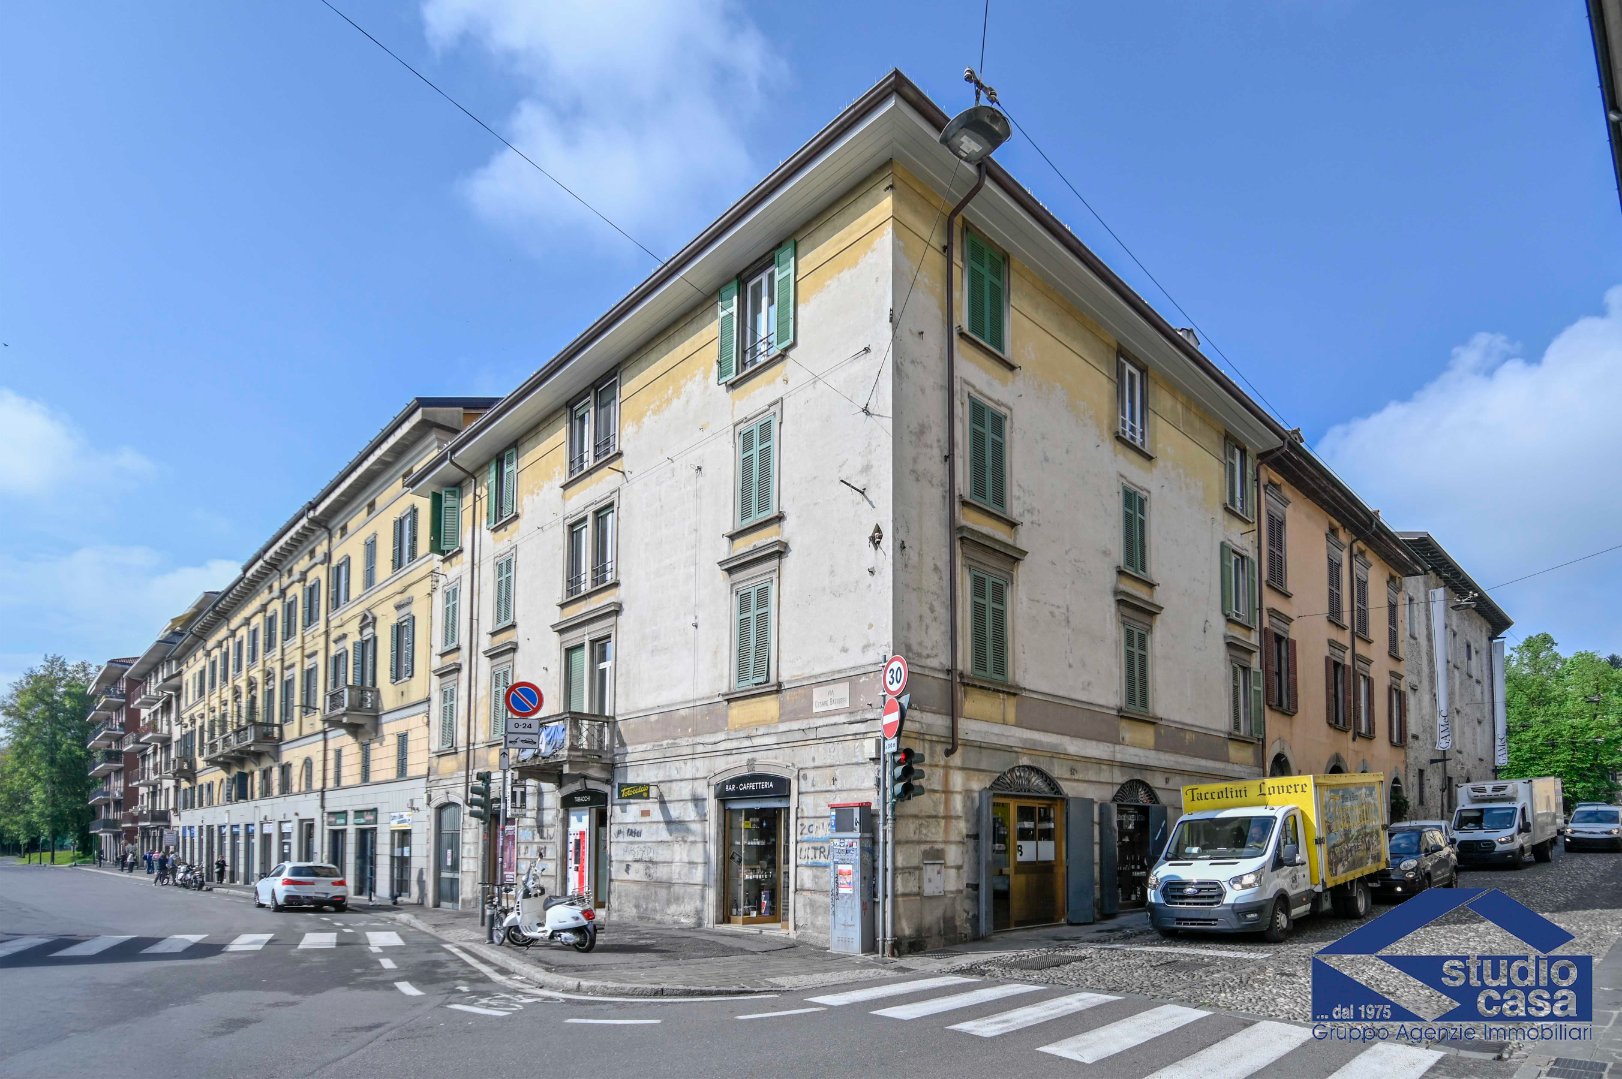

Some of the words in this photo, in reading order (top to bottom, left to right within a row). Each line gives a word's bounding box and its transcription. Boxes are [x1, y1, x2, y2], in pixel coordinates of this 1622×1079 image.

[888, 666, 902, 686] 30
[1438, 709, 1451, 749] GAMeC
[725, 784, 736, 792] BAR
[738, 781, 774, 791] CAFFETTERIA
[1185, 786, 1248, 803] Taccolini
[1257, 781, 1308, 797] Lovere
